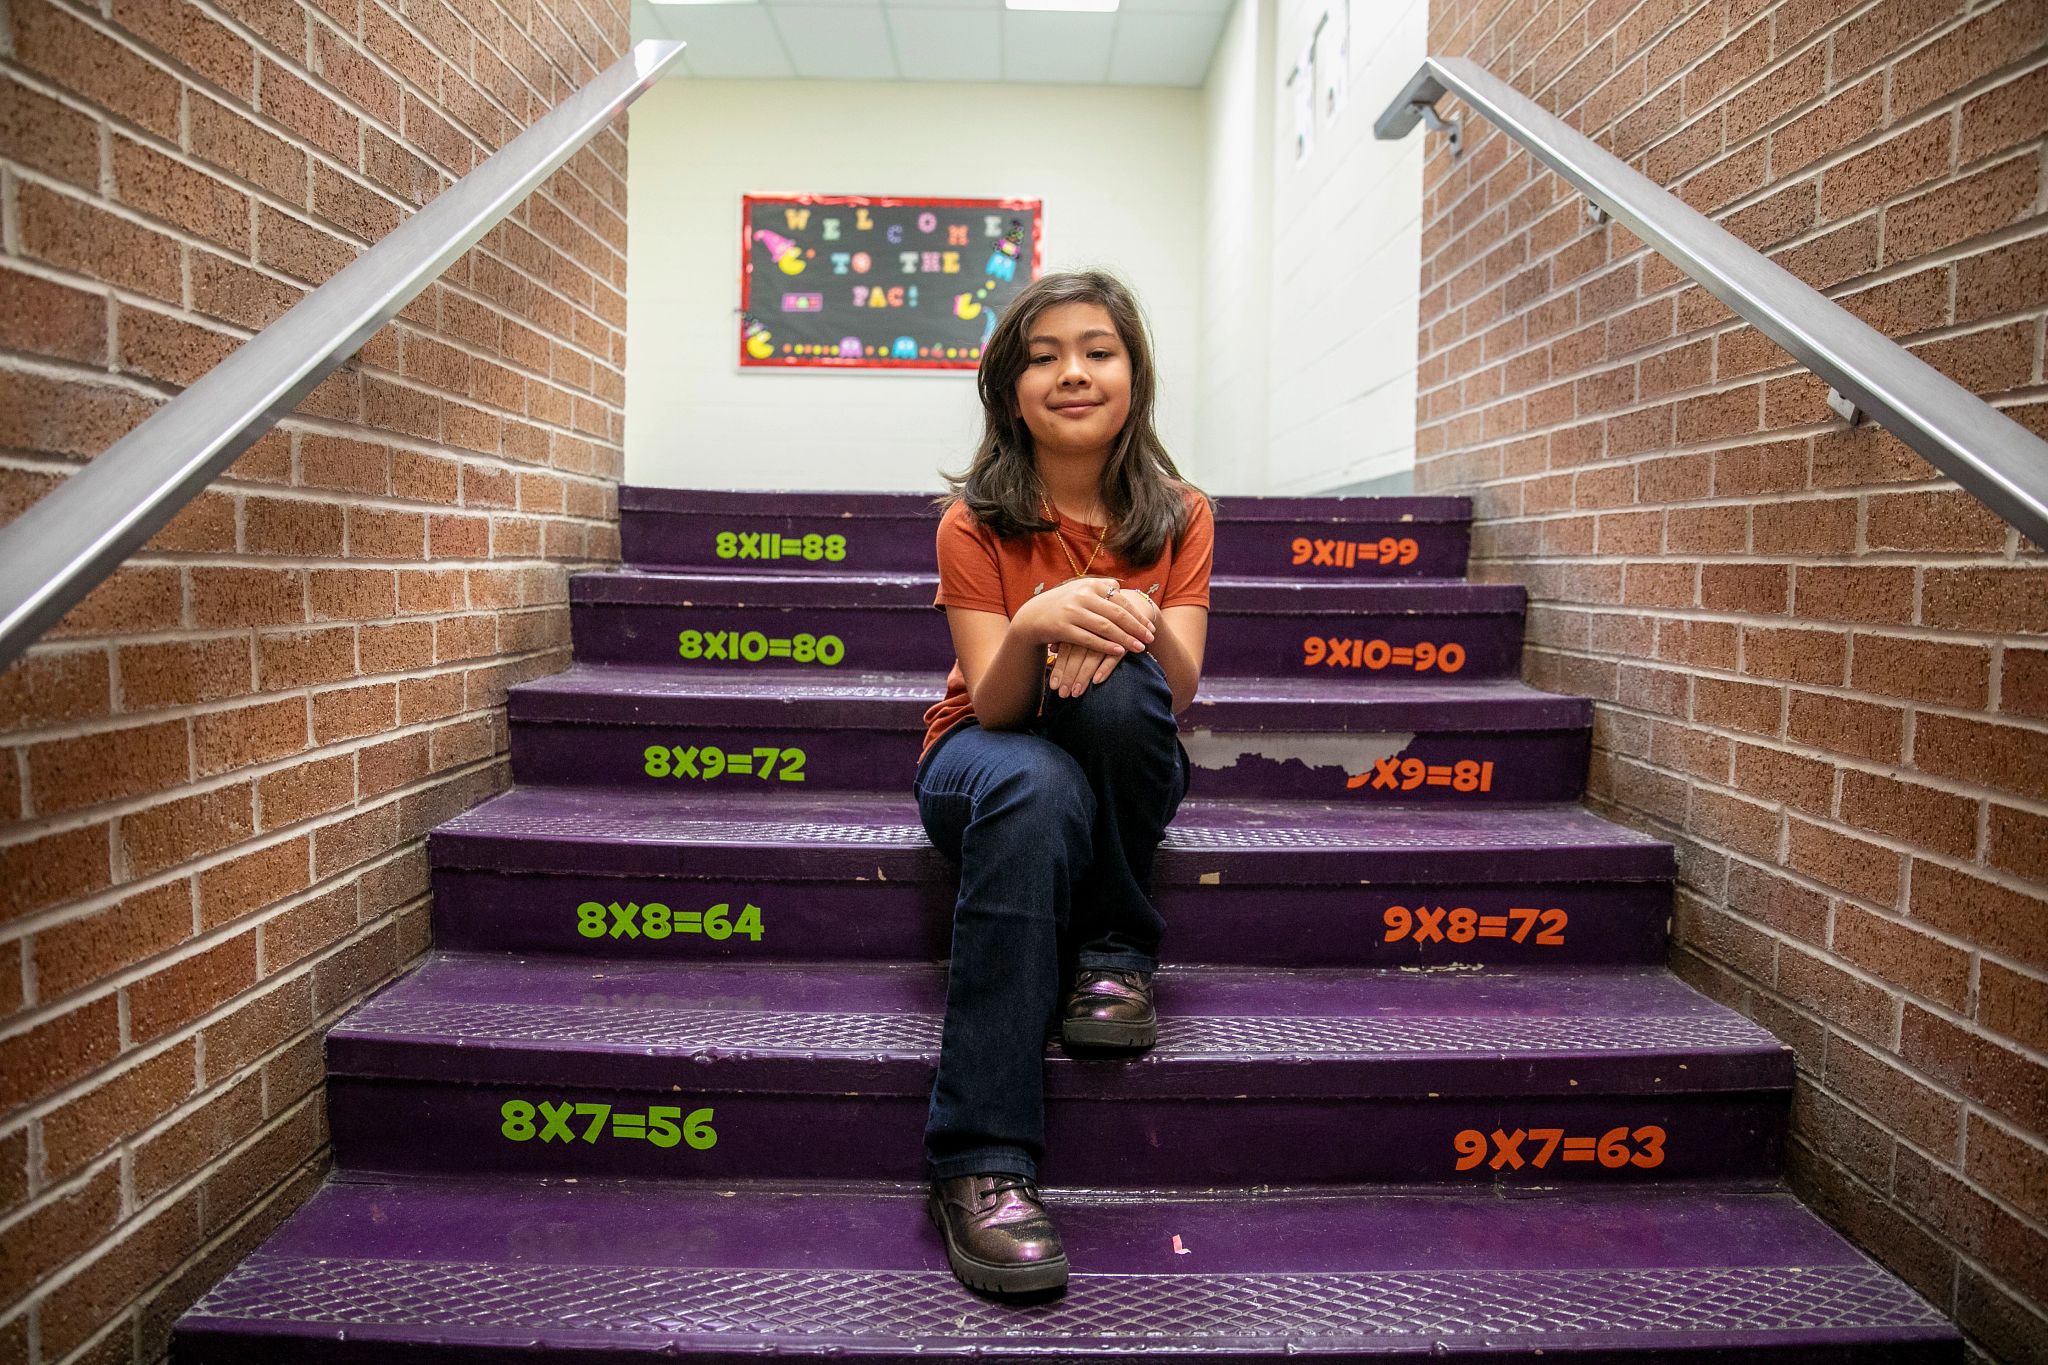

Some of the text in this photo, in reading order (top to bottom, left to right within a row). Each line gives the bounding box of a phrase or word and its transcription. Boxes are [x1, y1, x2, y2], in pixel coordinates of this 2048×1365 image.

[784, 207, 1002, 247] WELCOME
[831, 250, 961, 275] TO THE
[852, 285, 919, 308] PAC!
[715, 531, 847, 562] 8X11=88
[1291, 537, 1419, 569] 9X11=99
[678, 630, 845, 666] 8X10=80
[1303, 636, 1467, 673] 9X10=90
[644, 745, 806, 782] 8X9=72
[576, 901, 765, 942] 8X8=64
[1383, 905, 1569, 946] 9X8=72
[500, 1099, 718, 1151] 8X7=56
[1454, 1125, 1667, 1172] 9X7=63
